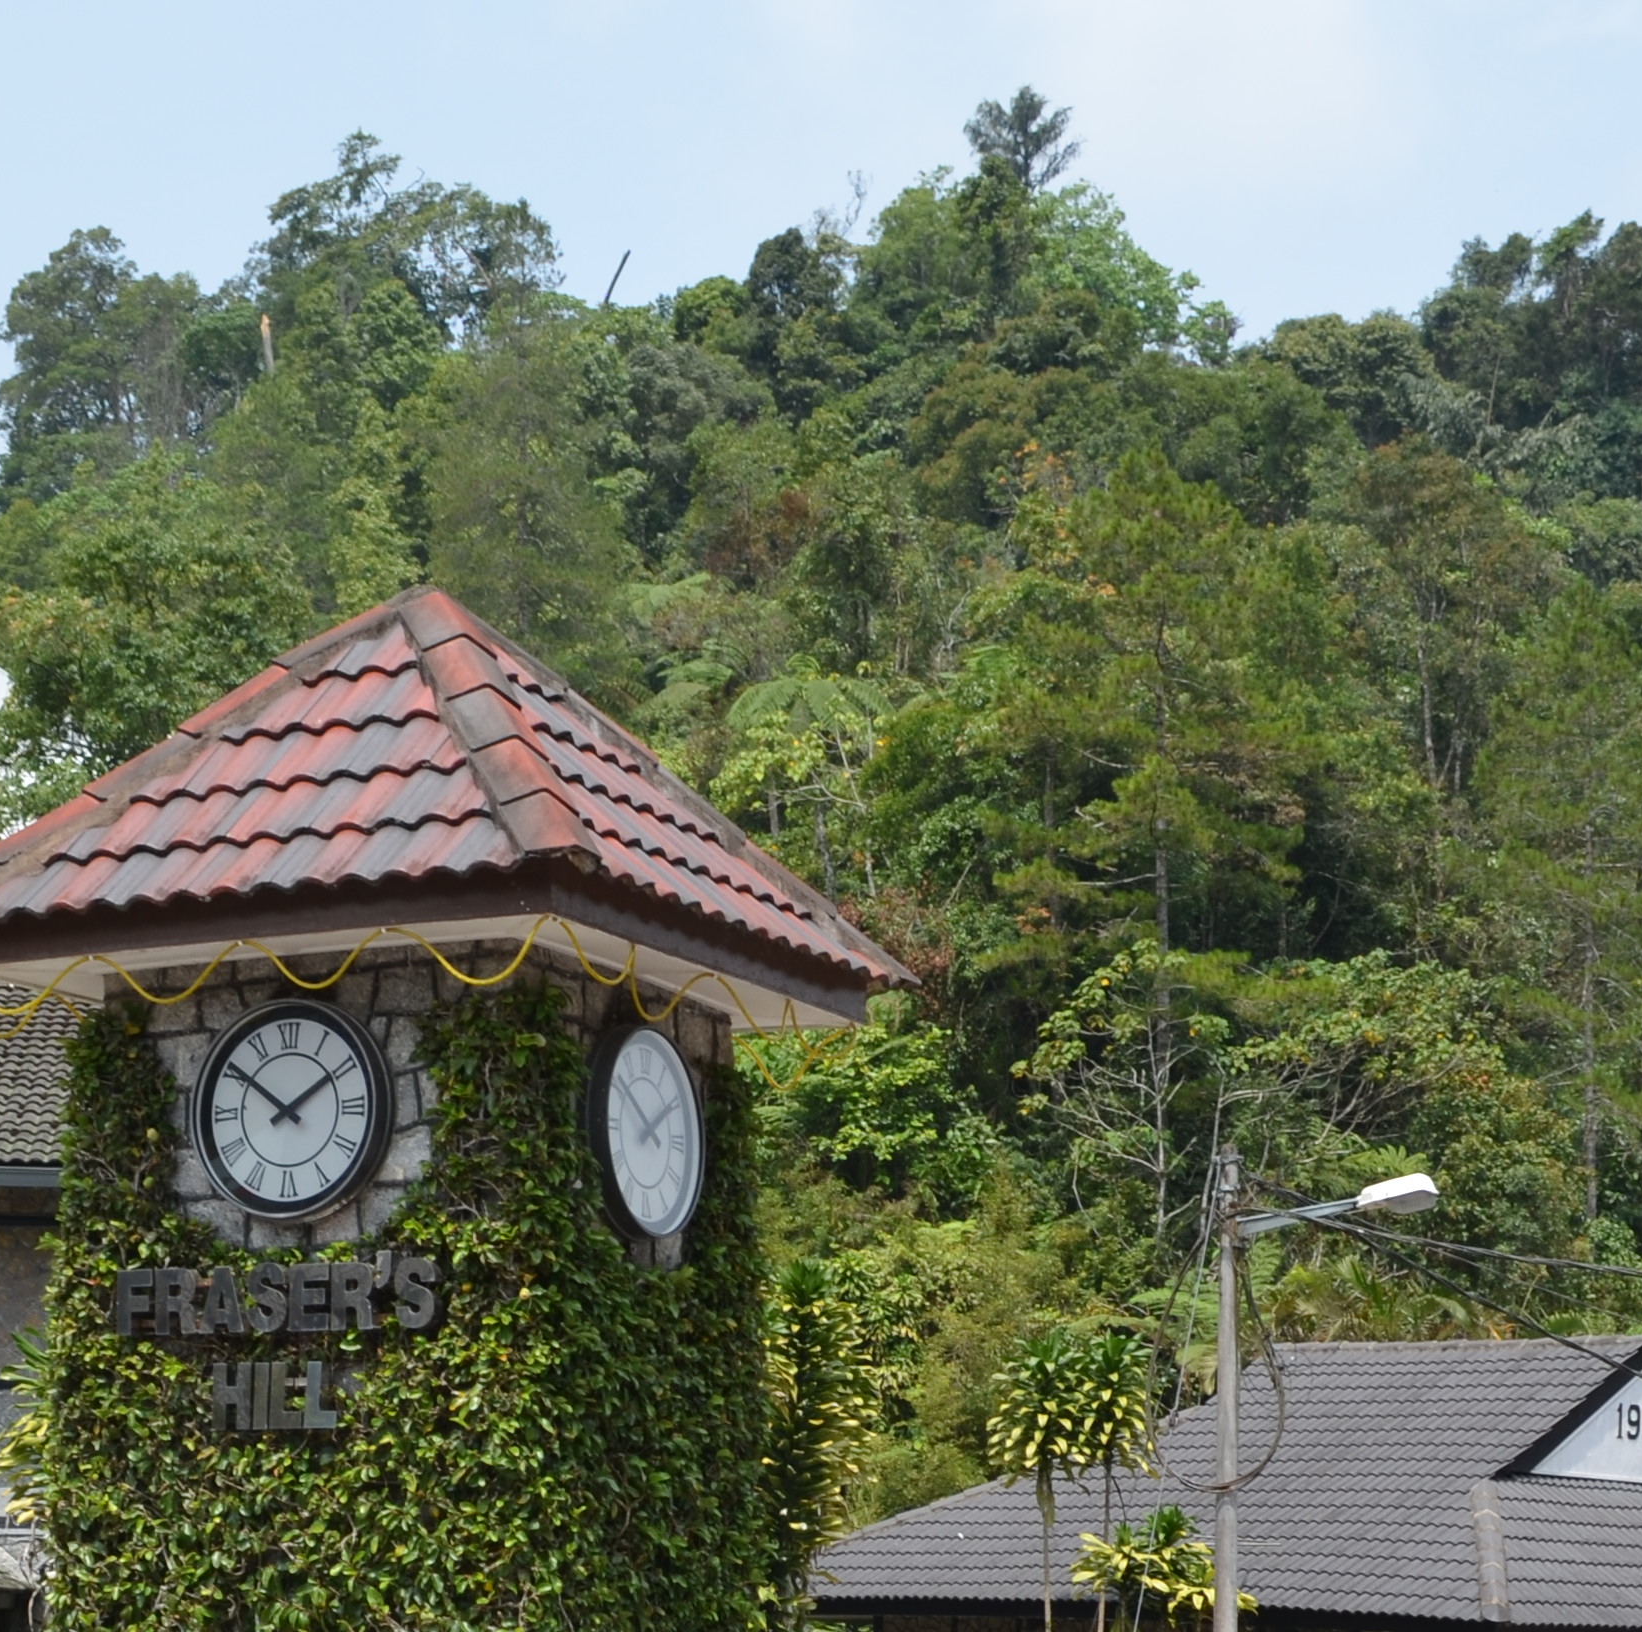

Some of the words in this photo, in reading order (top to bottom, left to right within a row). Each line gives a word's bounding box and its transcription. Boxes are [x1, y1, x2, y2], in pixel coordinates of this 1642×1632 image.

[247, 1032, 269, 1062] XI
[277, 1022, 301, 1050] XII
[215, 1104, 238, 1124] IX
[342, 1094, 365, 1117] III
[116, 1250, 440, 1336] FRASER'S
[212, 1361, 338, 1430] HILL
